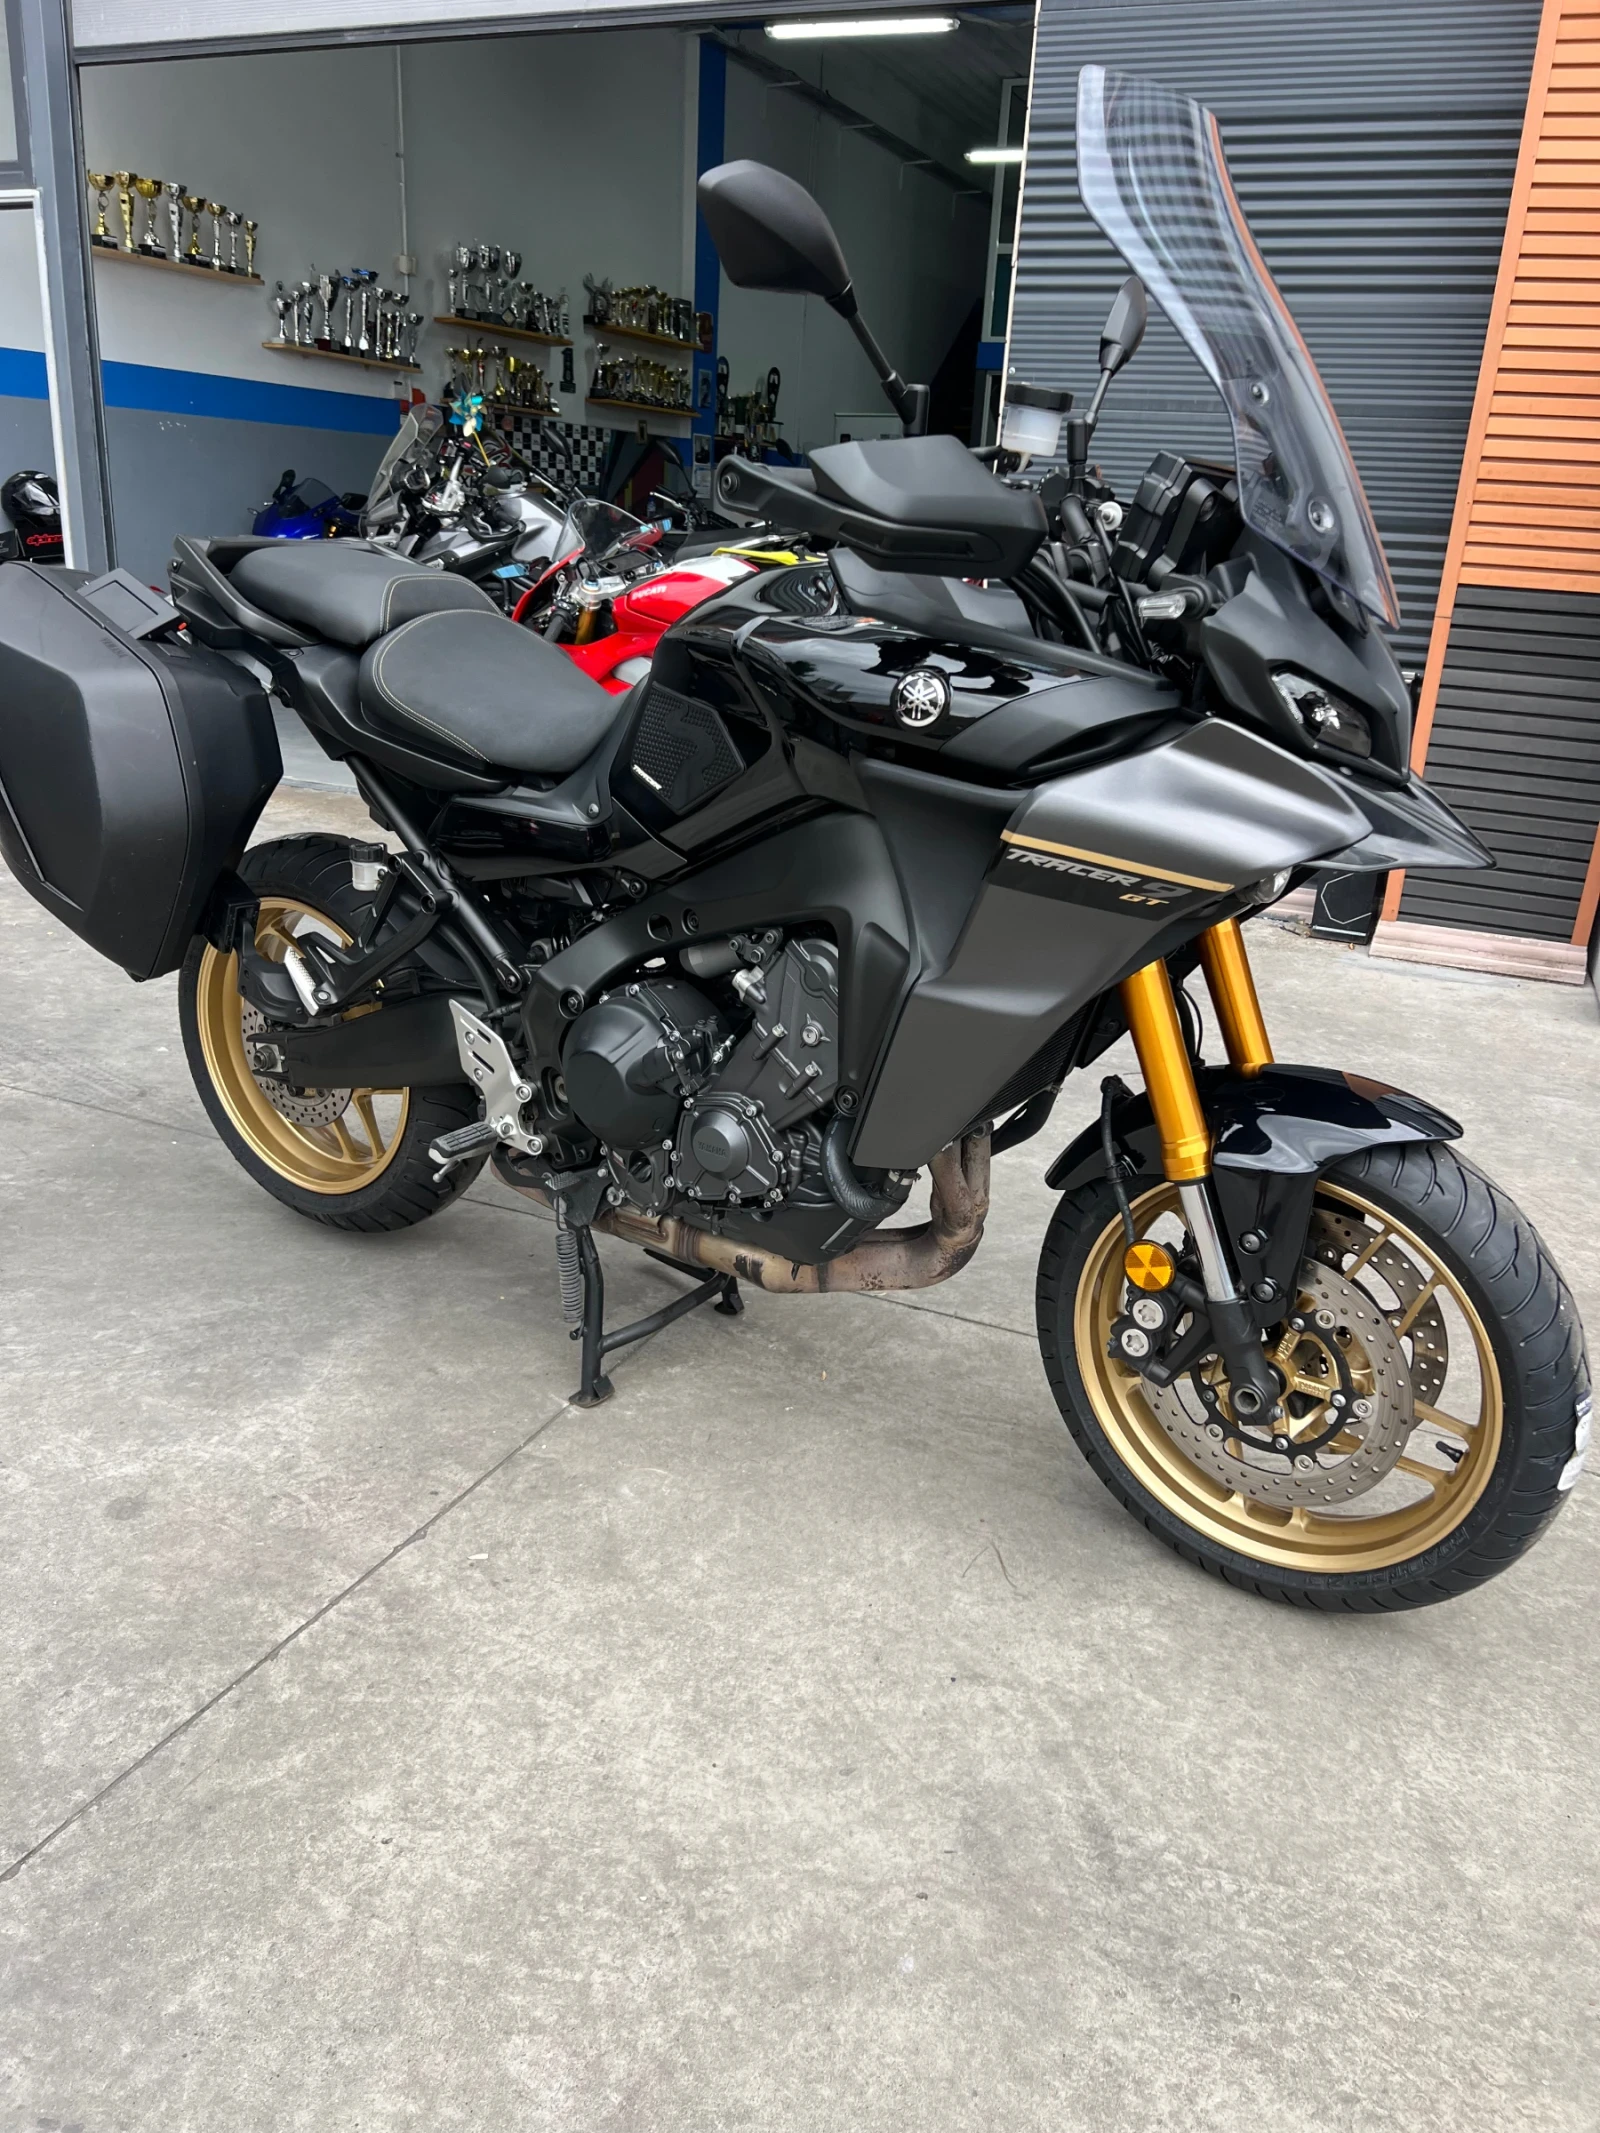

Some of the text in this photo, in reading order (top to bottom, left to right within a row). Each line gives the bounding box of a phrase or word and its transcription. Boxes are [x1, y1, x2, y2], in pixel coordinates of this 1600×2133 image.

[631, 584, 667, 600] DUCATI
[632, 764, 662, 790] TRACER
[1005, 848, 1193, 899] TRACER 9
[1118, 893, 1170, 906] GT
